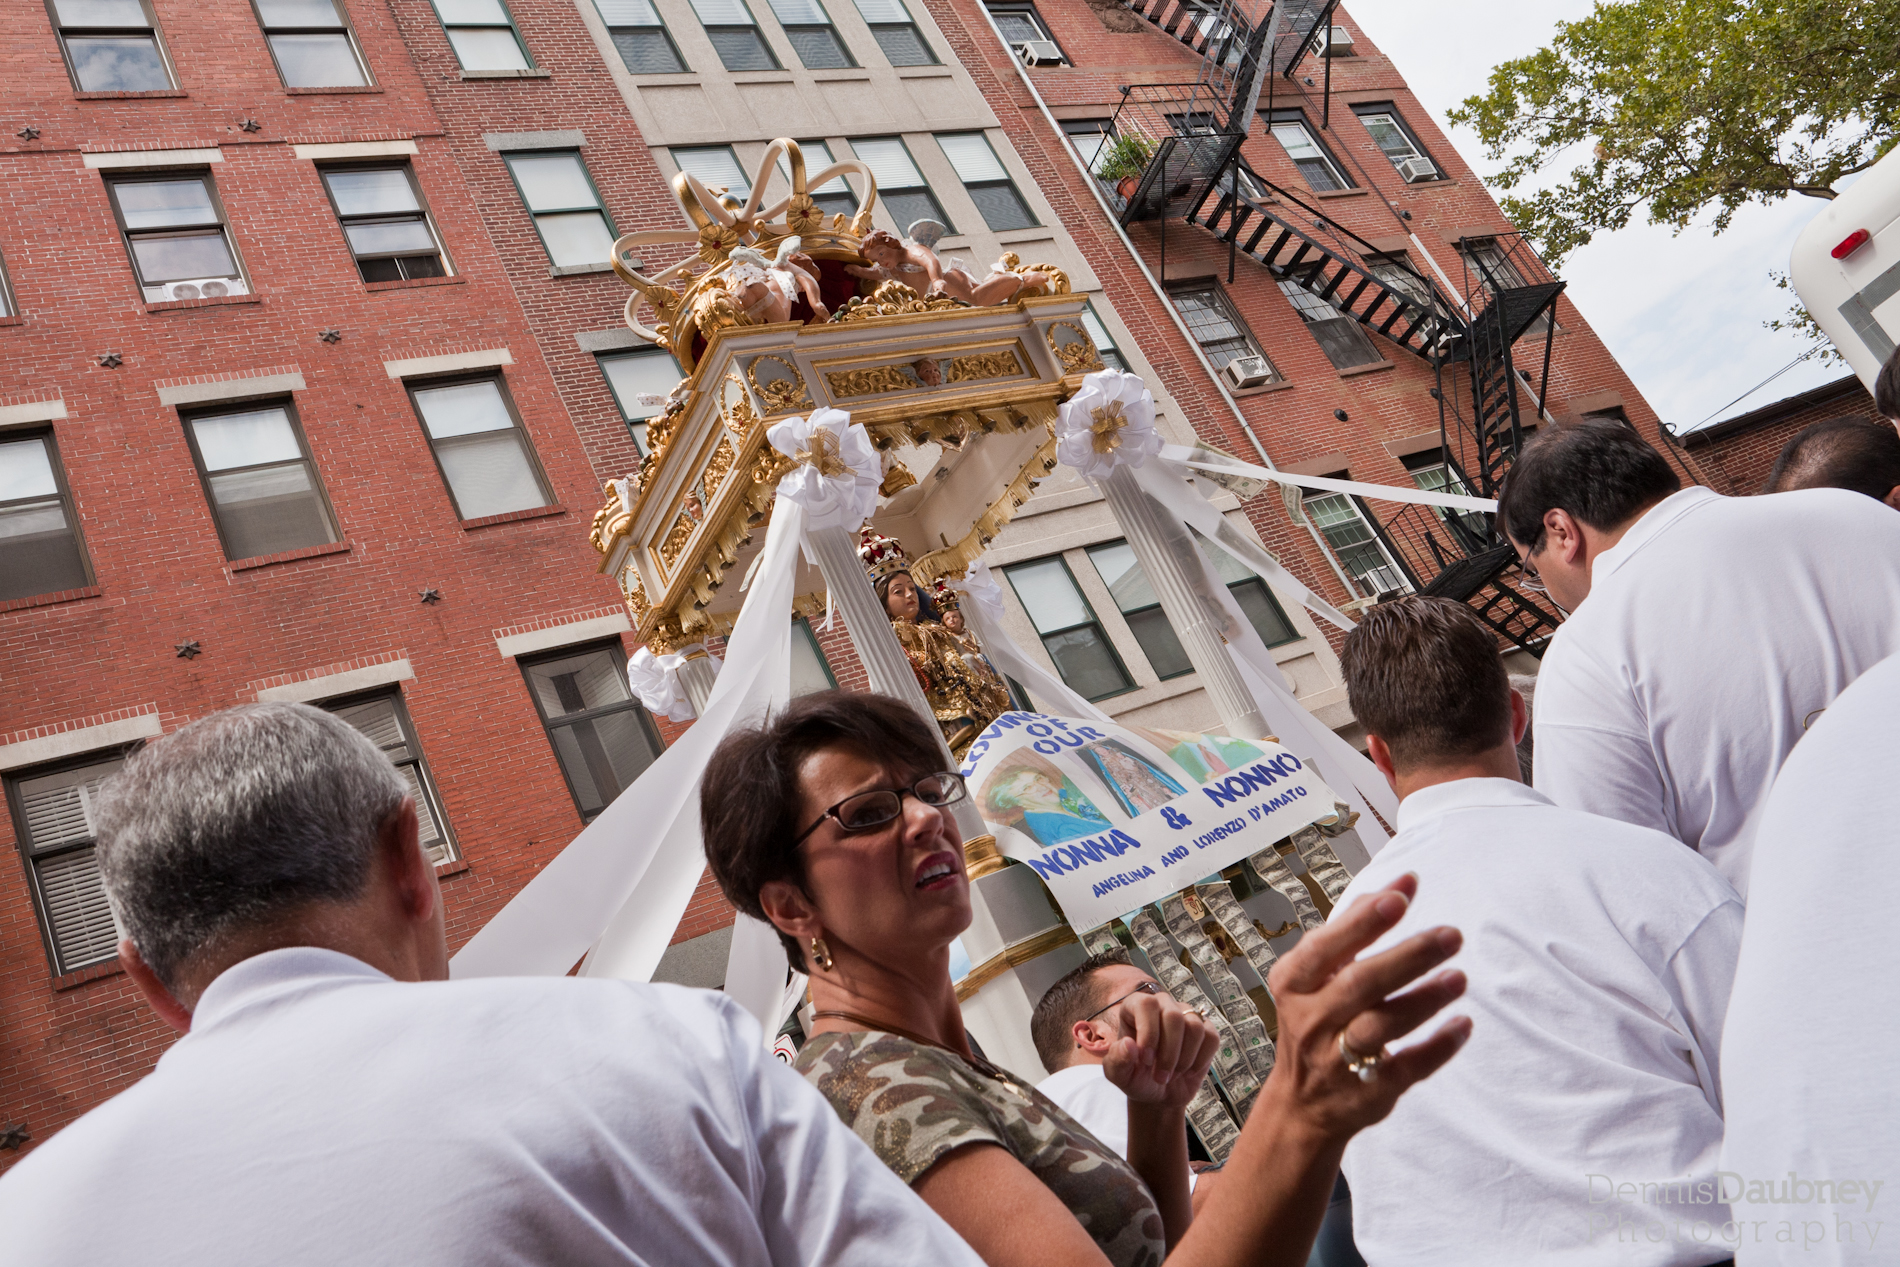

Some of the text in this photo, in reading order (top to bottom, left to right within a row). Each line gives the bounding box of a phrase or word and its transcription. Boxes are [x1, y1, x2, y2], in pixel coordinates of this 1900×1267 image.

[1026, 718, 1069, 737] OF
[1033, 726, 1106, 754] OUR
[1028, 753, 1302, 880] NONNA & NONNO
[1092, 786, 1307, 898] ANGELINA AND LORENZO D'AMATO
